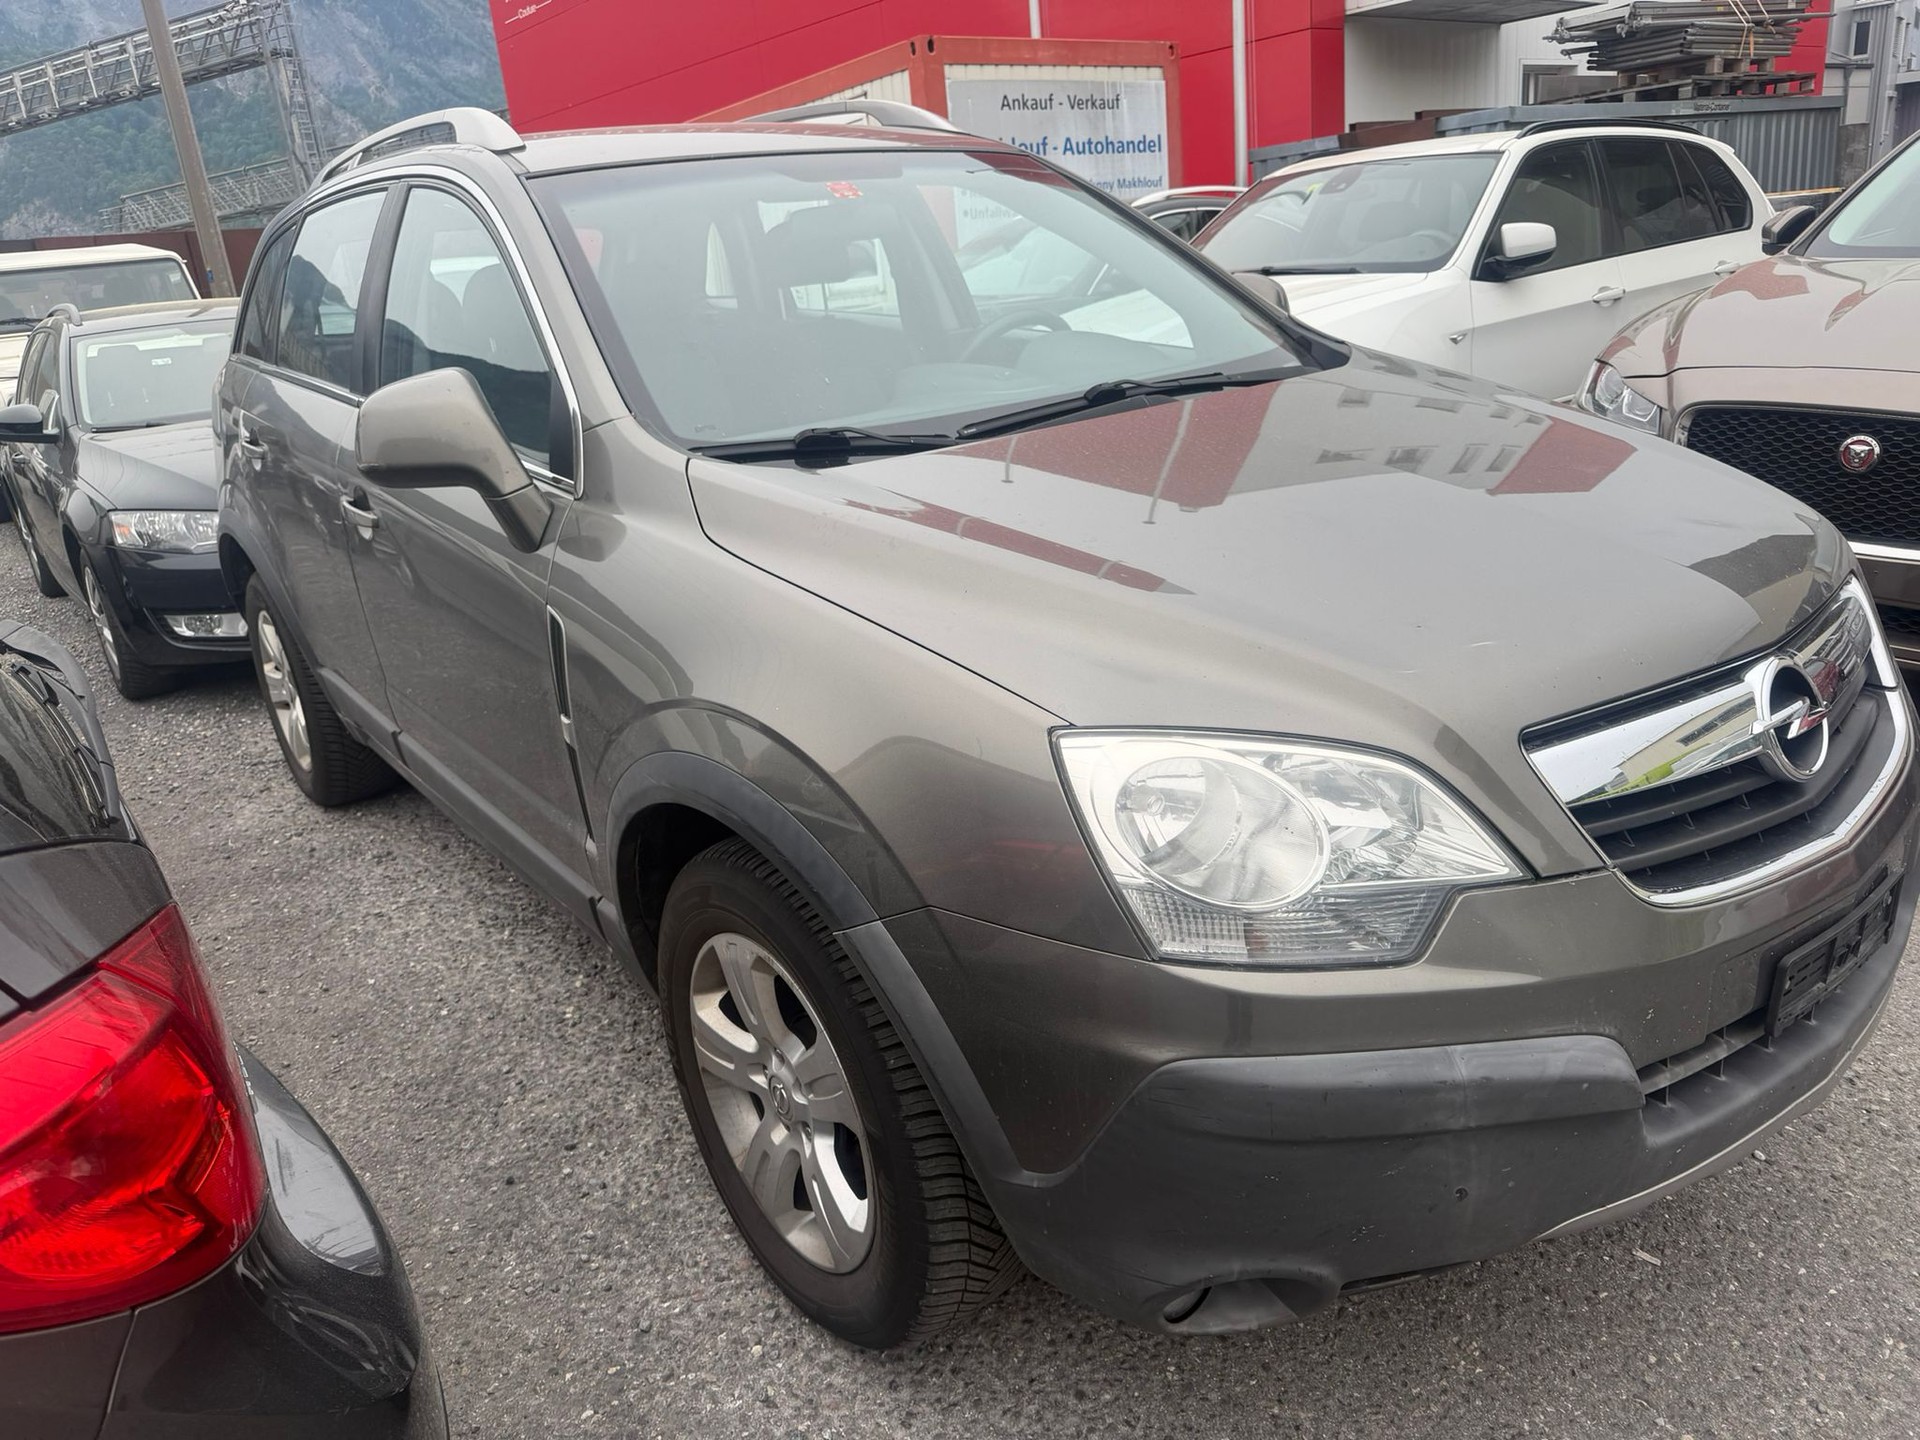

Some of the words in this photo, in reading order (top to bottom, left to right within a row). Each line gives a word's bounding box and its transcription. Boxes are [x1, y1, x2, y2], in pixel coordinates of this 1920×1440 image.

[1000, 93, 1054, 111] Ankauf
[1067, 93, 1121, 111] Verkauf
[1063, 133, 1162, 156] Autohandel
[1117, 176, 1163, 190] Makhlouf
